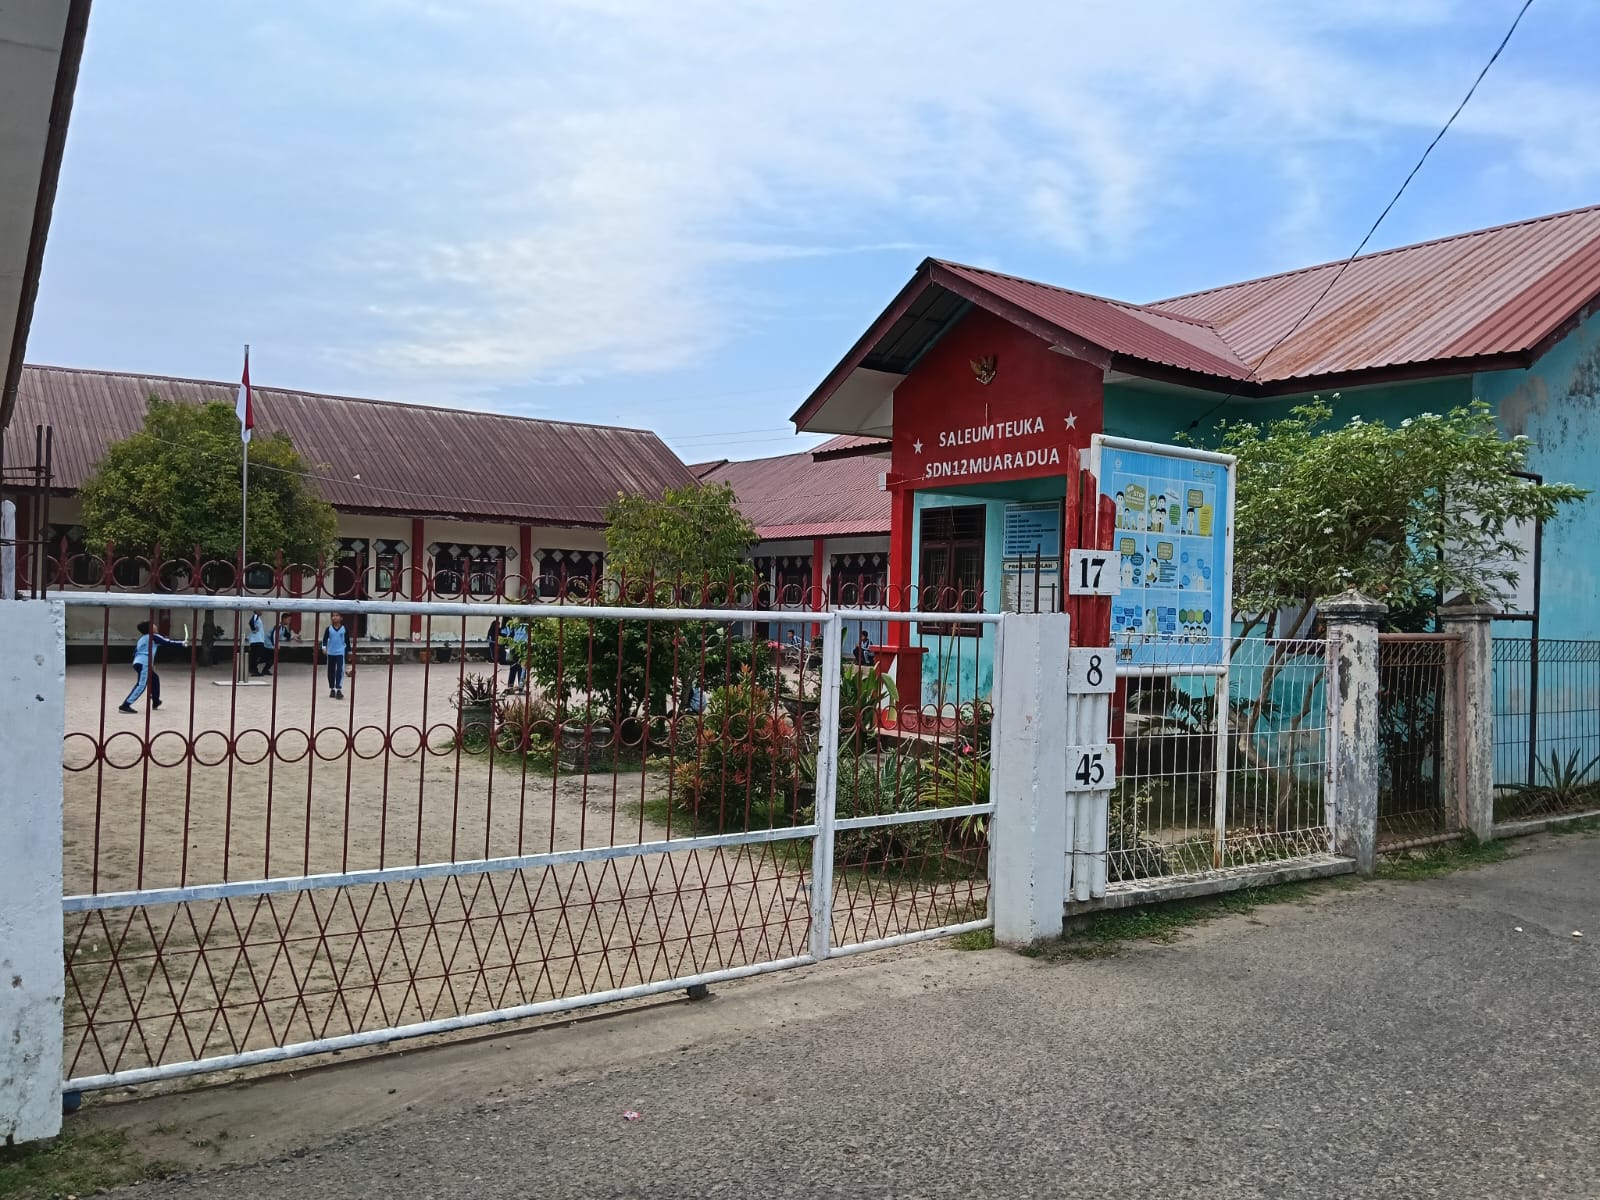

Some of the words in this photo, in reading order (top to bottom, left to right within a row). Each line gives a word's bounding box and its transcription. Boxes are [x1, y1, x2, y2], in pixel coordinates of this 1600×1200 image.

[939, 424, 994, 448] SALEUM
[996, 416, 1045, 439] TEUKA
[925, 462, 952, 479] SDN
[969, 451, 1024, 474] MUARA
[1026, 447, 1060, 466] DUA
[1080, 557, 1106, 588] 17
[1087, 655, 1102, 686] 8
[1075, 753, 1104, 785] 45
